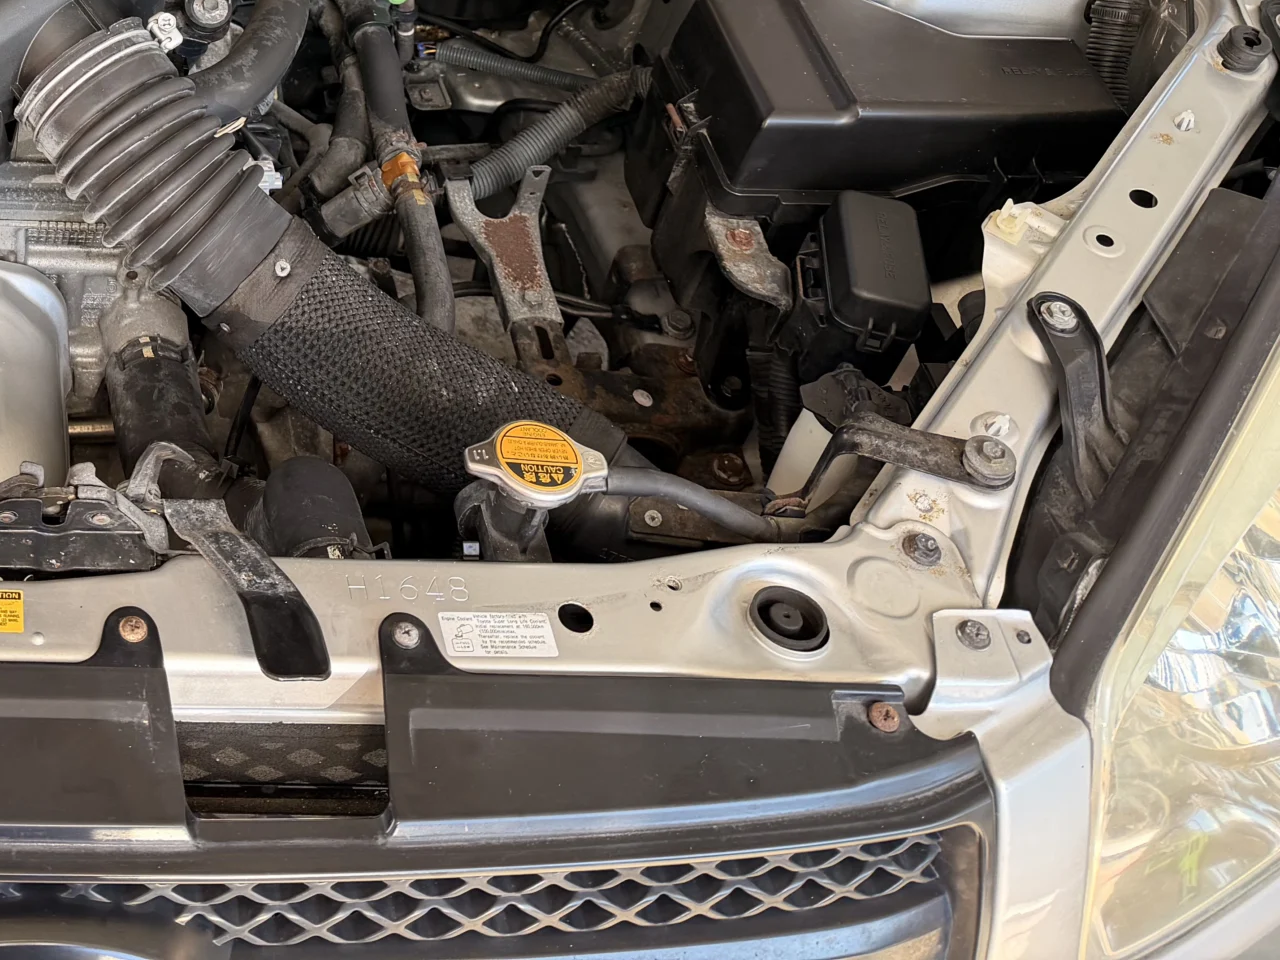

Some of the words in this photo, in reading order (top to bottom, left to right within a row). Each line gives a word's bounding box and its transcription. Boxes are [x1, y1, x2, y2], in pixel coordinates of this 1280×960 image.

[472, 449, 490, 460] 1.1
[521, 464, 563, 474] CAUTION
[346, 574, 469, 602] H1648
